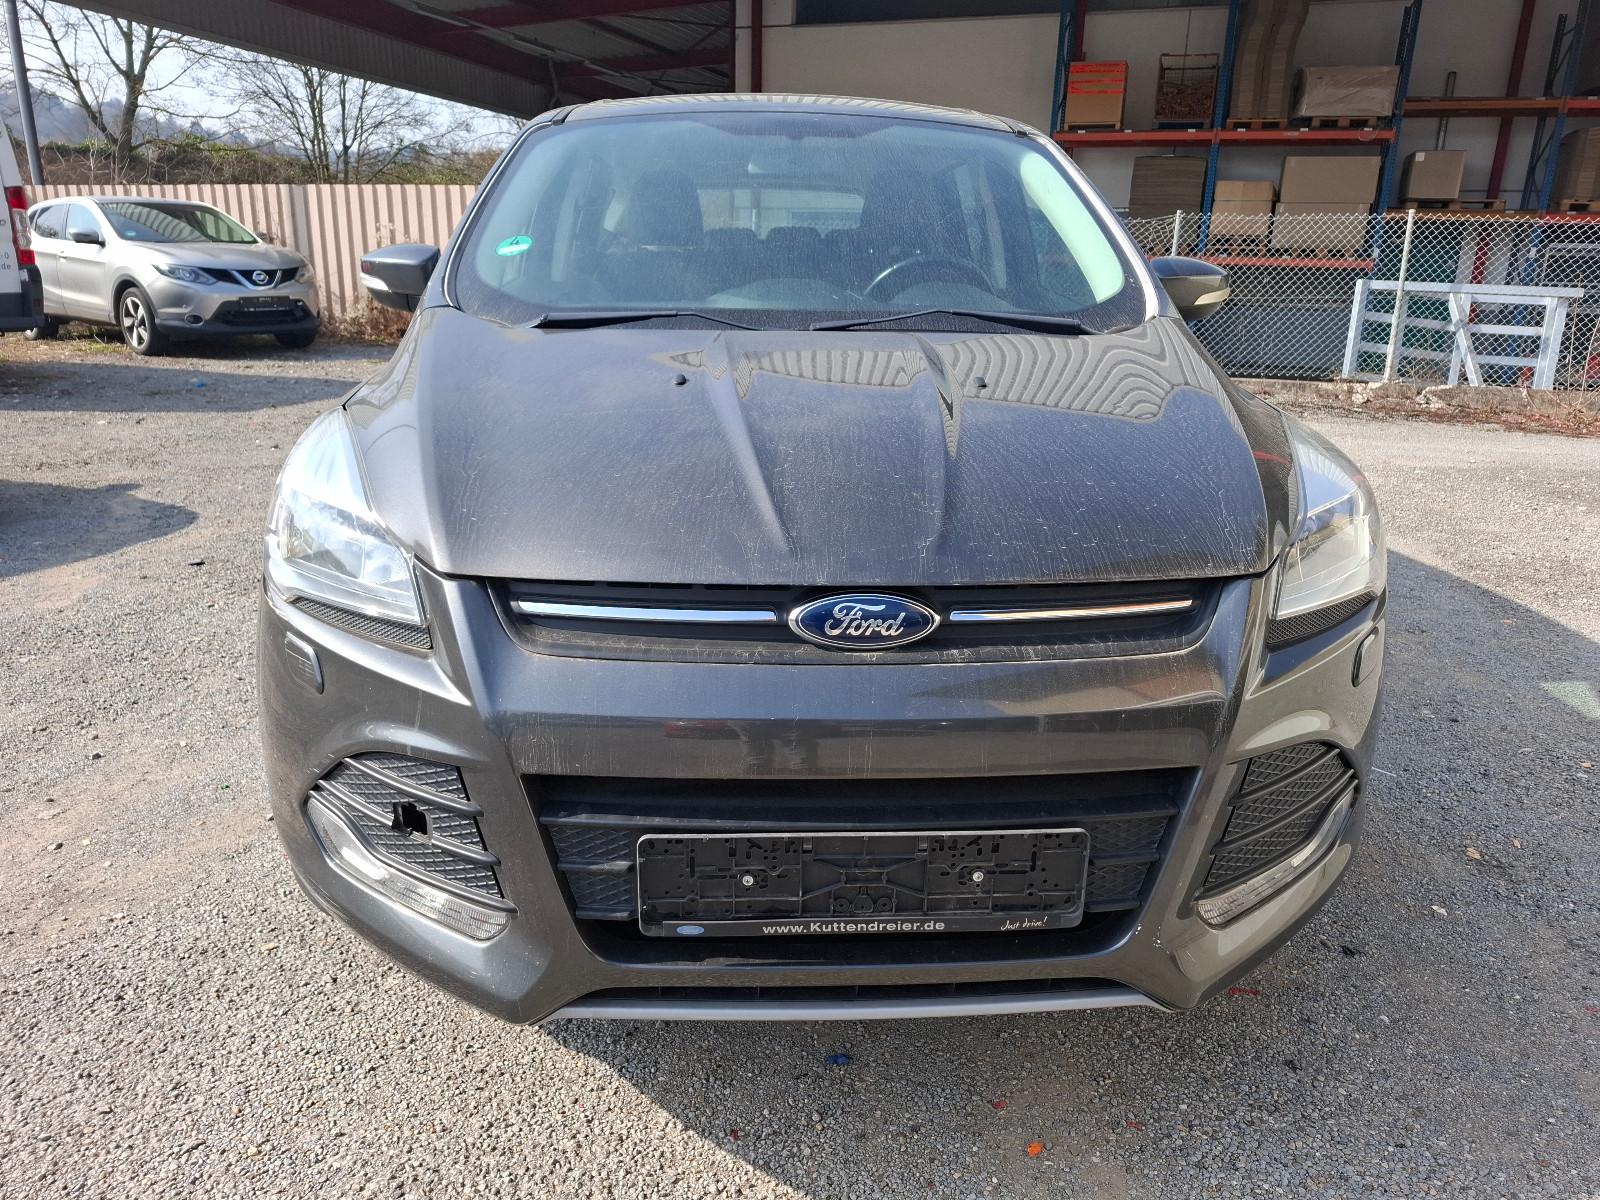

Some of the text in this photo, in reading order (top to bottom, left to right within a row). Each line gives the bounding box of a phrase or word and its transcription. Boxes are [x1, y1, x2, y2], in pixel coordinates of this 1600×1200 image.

[510, 236, 520, 246] 4
[824, 602, 906, 636] Ford
[762, 921, 945, 934] www.Kuttendreier.de
